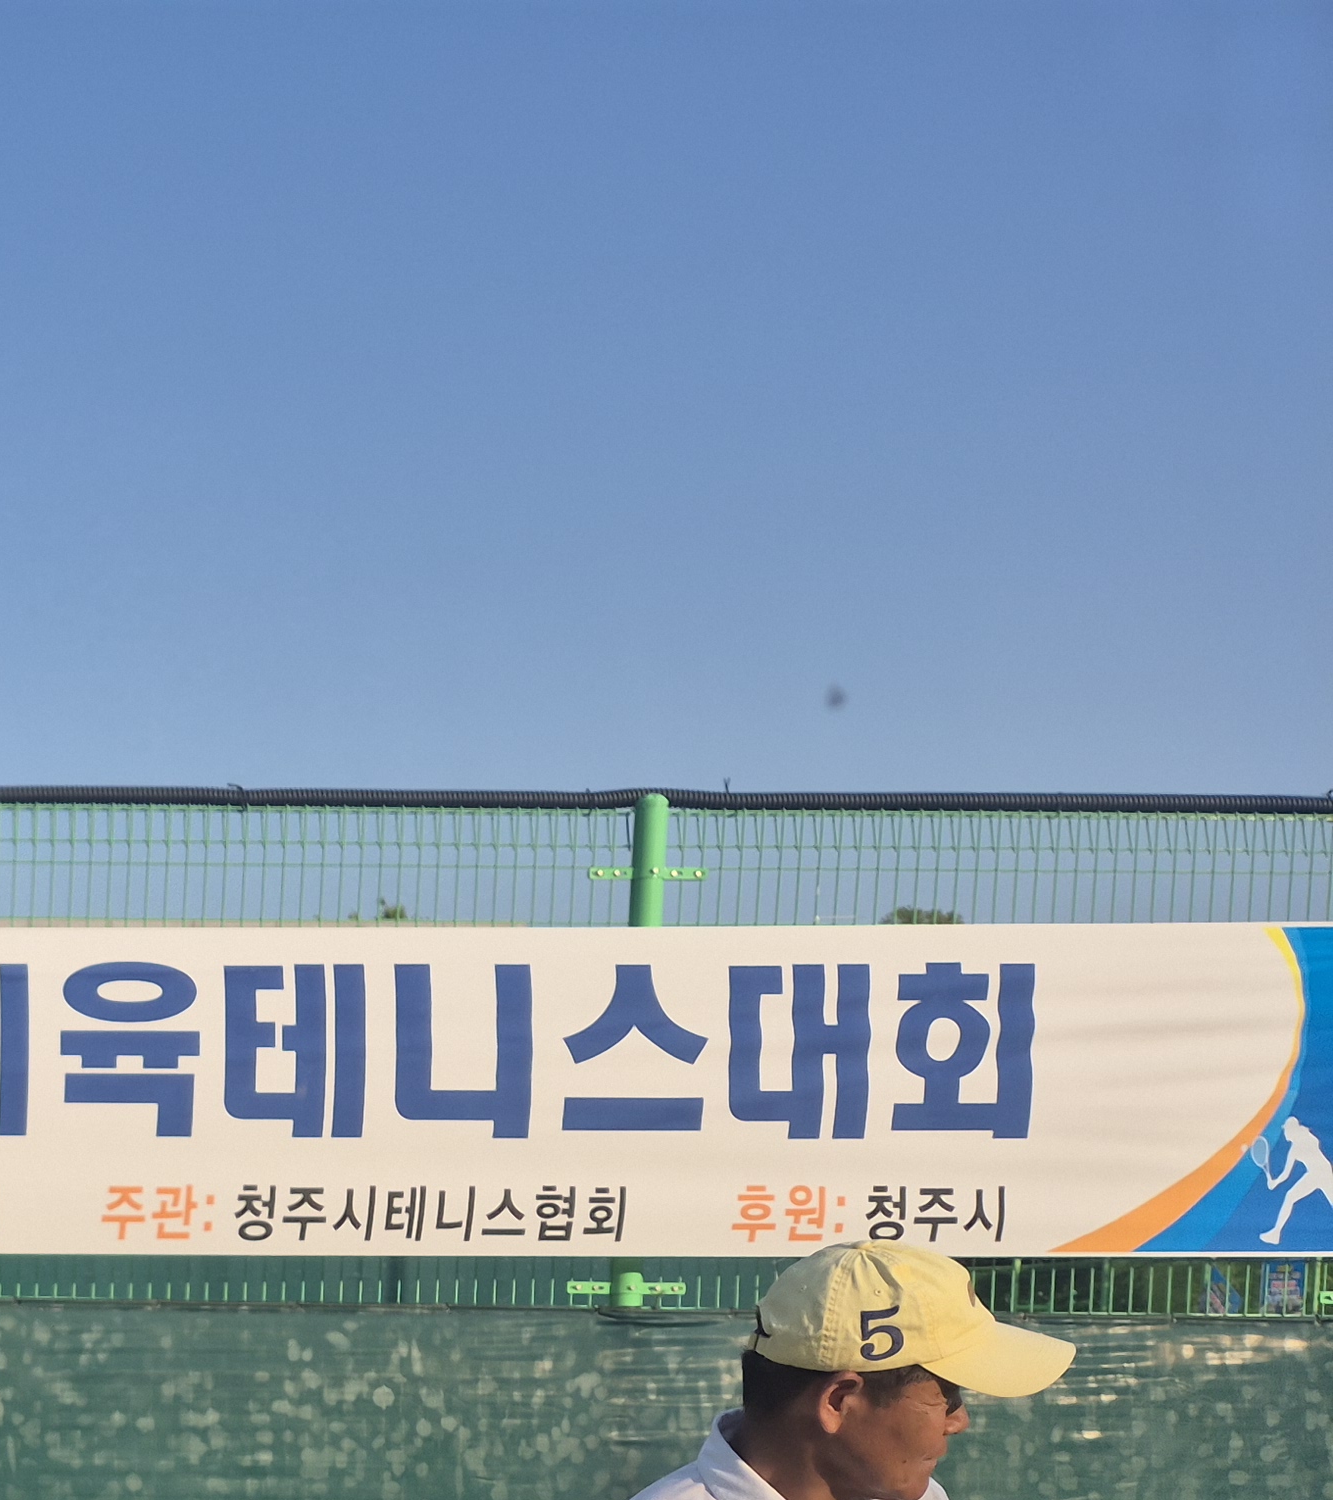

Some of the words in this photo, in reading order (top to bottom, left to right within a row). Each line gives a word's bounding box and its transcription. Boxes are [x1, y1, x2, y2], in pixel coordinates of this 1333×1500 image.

[234, 1184, 628, 1243] 청주시테니스협회
[864, 1185, 1007, 1243] 청주시
[860, 1304, 904, 1361] 5
